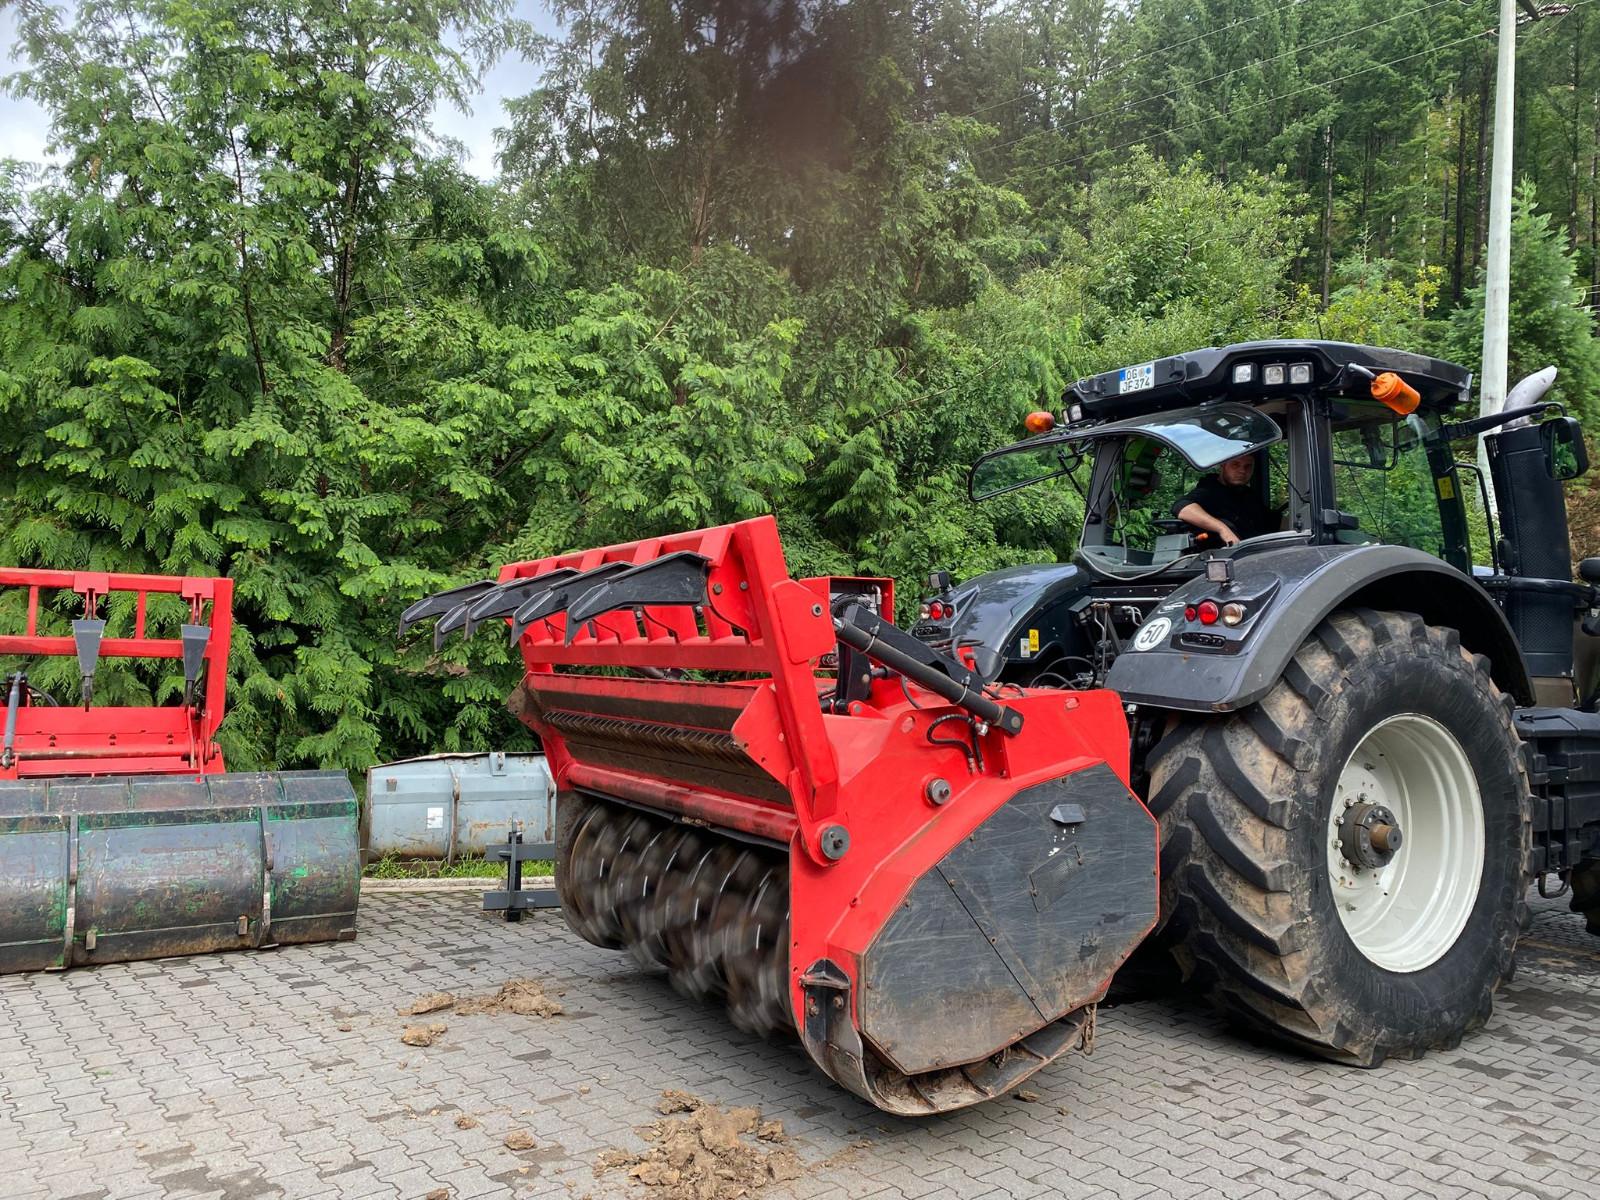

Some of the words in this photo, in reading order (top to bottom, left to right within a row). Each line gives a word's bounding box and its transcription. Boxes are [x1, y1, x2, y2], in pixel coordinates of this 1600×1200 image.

[1126, 369, 1138, 380] OG
[1122, 381, 1133, 392] JF
[1134, 377, 1150, 390] 374
[1140, 624, 1165, 643] 50
